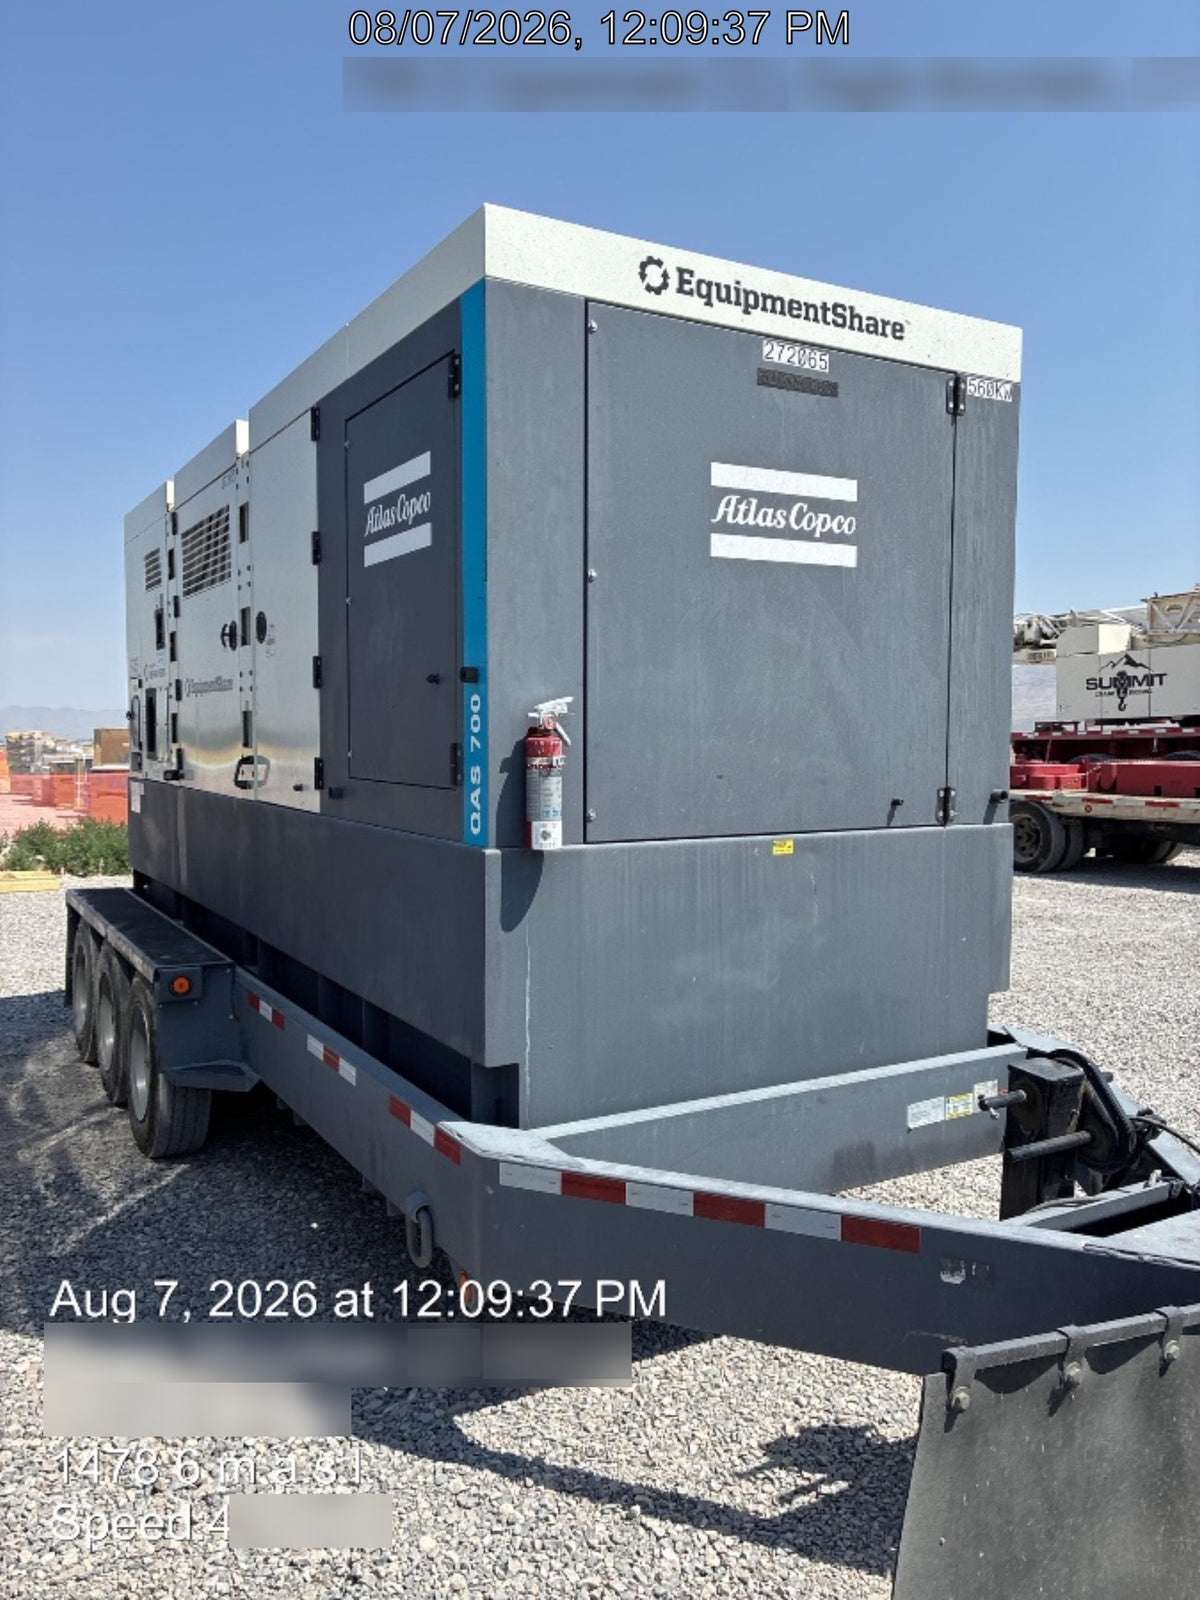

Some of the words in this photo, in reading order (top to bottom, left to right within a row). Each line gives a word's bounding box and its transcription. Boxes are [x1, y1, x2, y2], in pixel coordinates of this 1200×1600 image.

[676, 266, 905, 341] EquipmentShare
[364, 504, 396, 538] Atlas
[395, 492, 431, 525] Copco
[711, 494, 787, 529] Atlas
[789, 502, 856, 538] Copco
[1086, 673, 1168, 691] SUMMIT
[470, 693, 481, 752] 700
[470, 765, 481, 835] QAS
